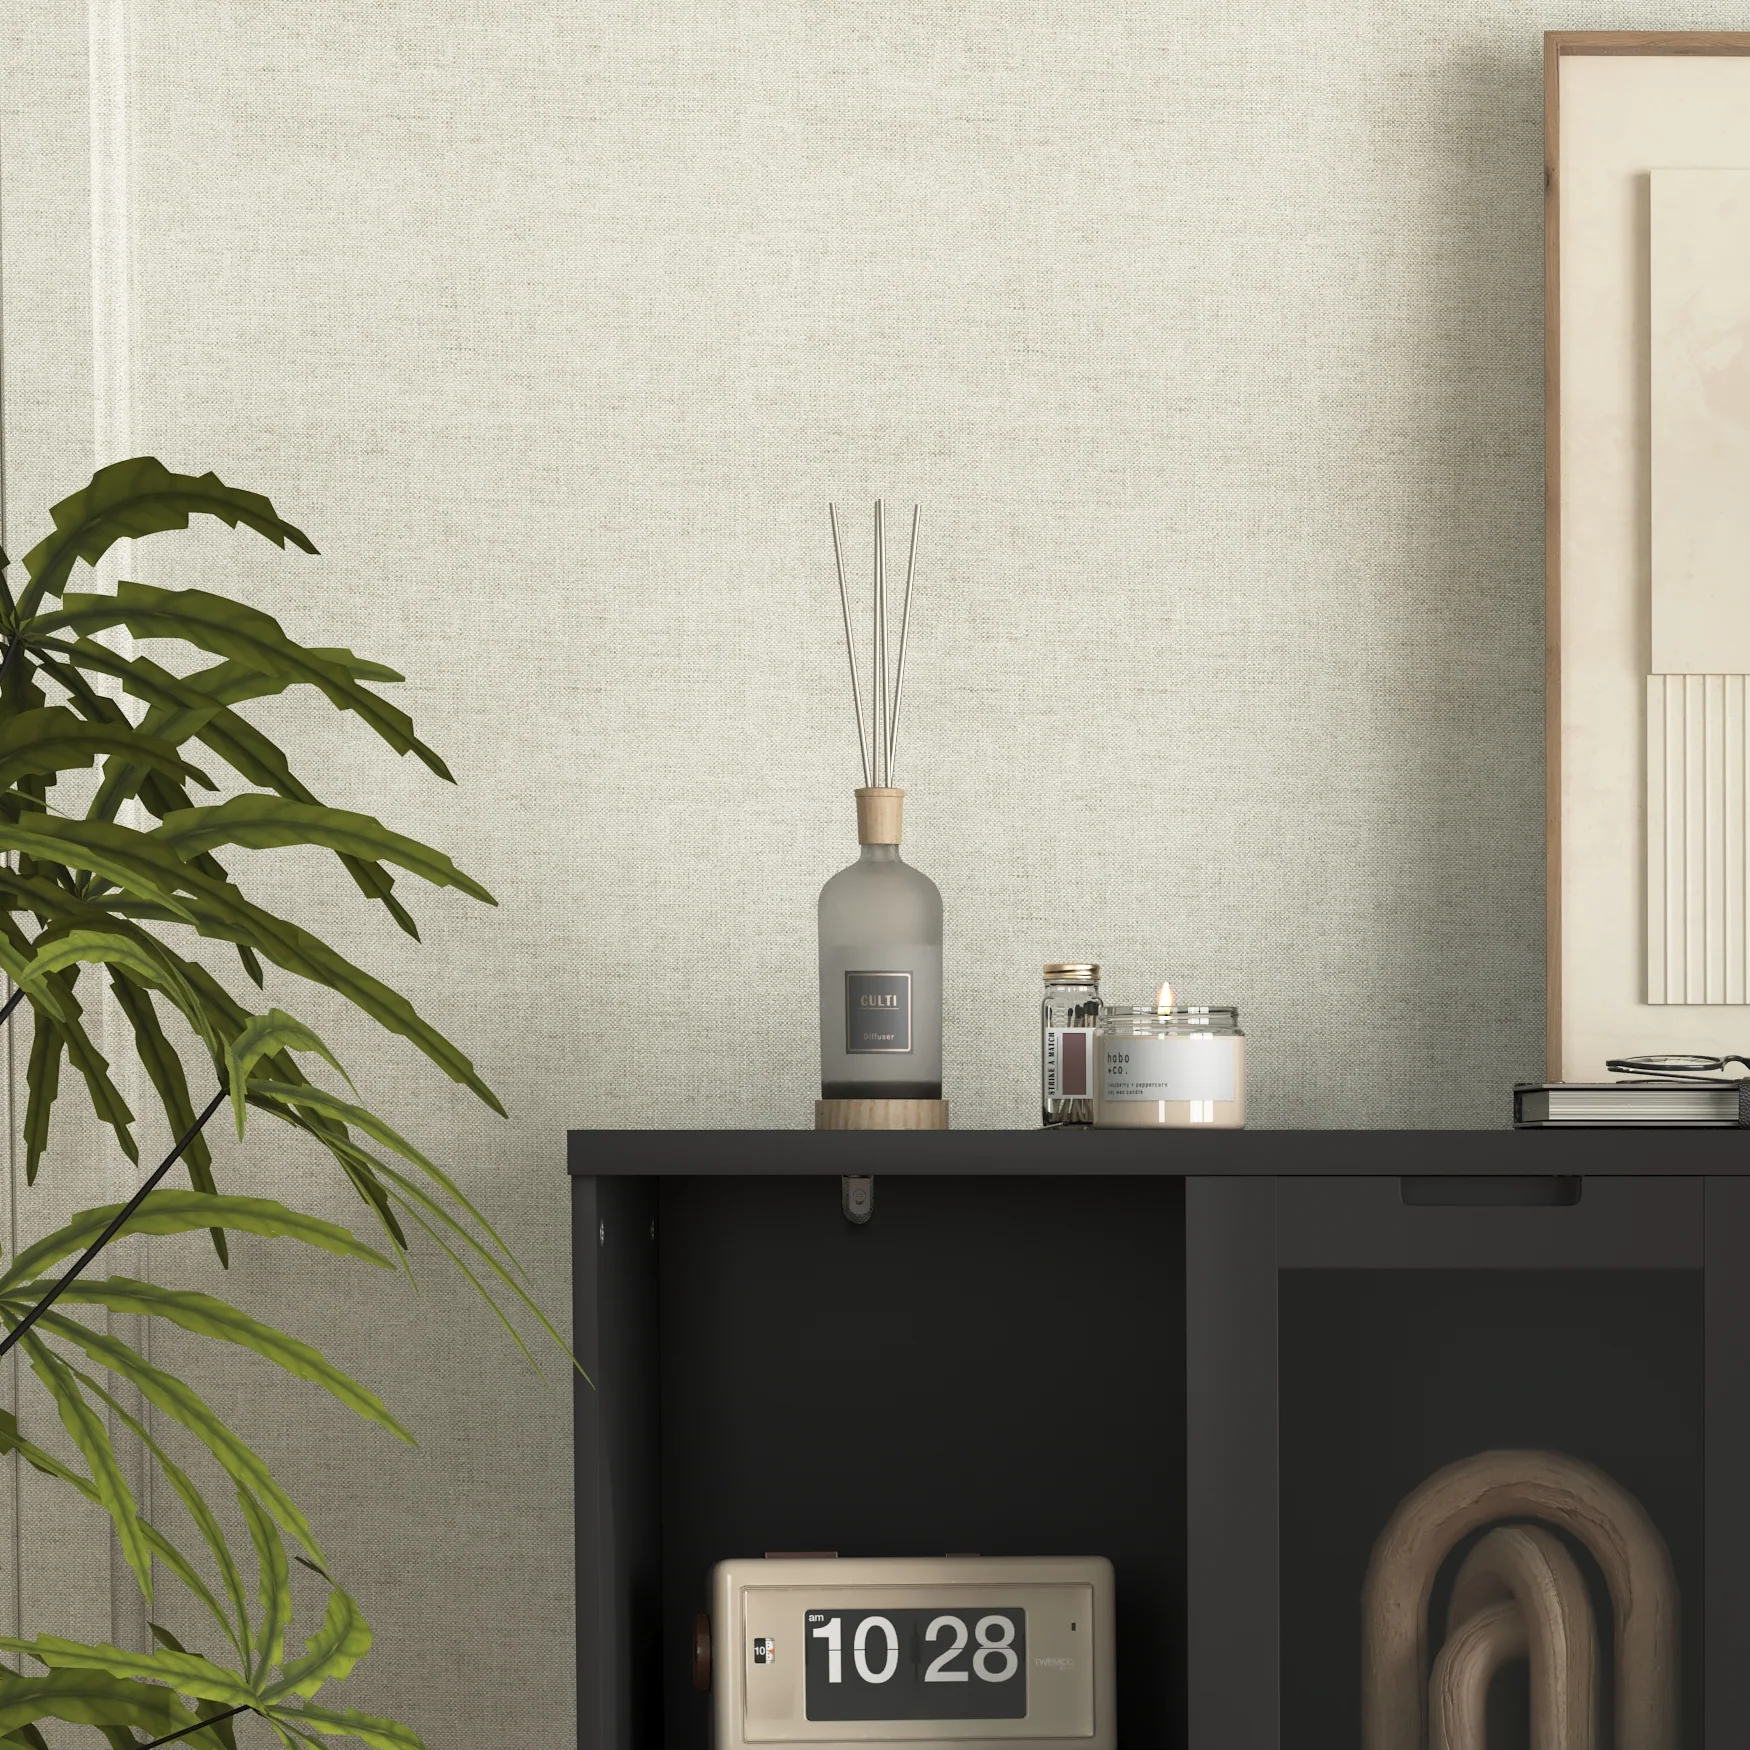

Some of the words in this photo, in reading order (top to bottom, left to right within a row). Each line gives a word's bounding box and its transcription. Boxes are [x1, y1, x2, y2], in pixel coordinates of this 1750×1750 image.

[860, 994, 897, 1007] CULTI
[863, 1032, 895, 1041] Diffuser
[1107, 1052, 1130, 1063] hobo
[808, 1613, 825, 1622] am
[754, 1645, 766, 1656] 10
[812, 1615, 899, 1684] 10
[924, 1614, 1019, 1683] 28
